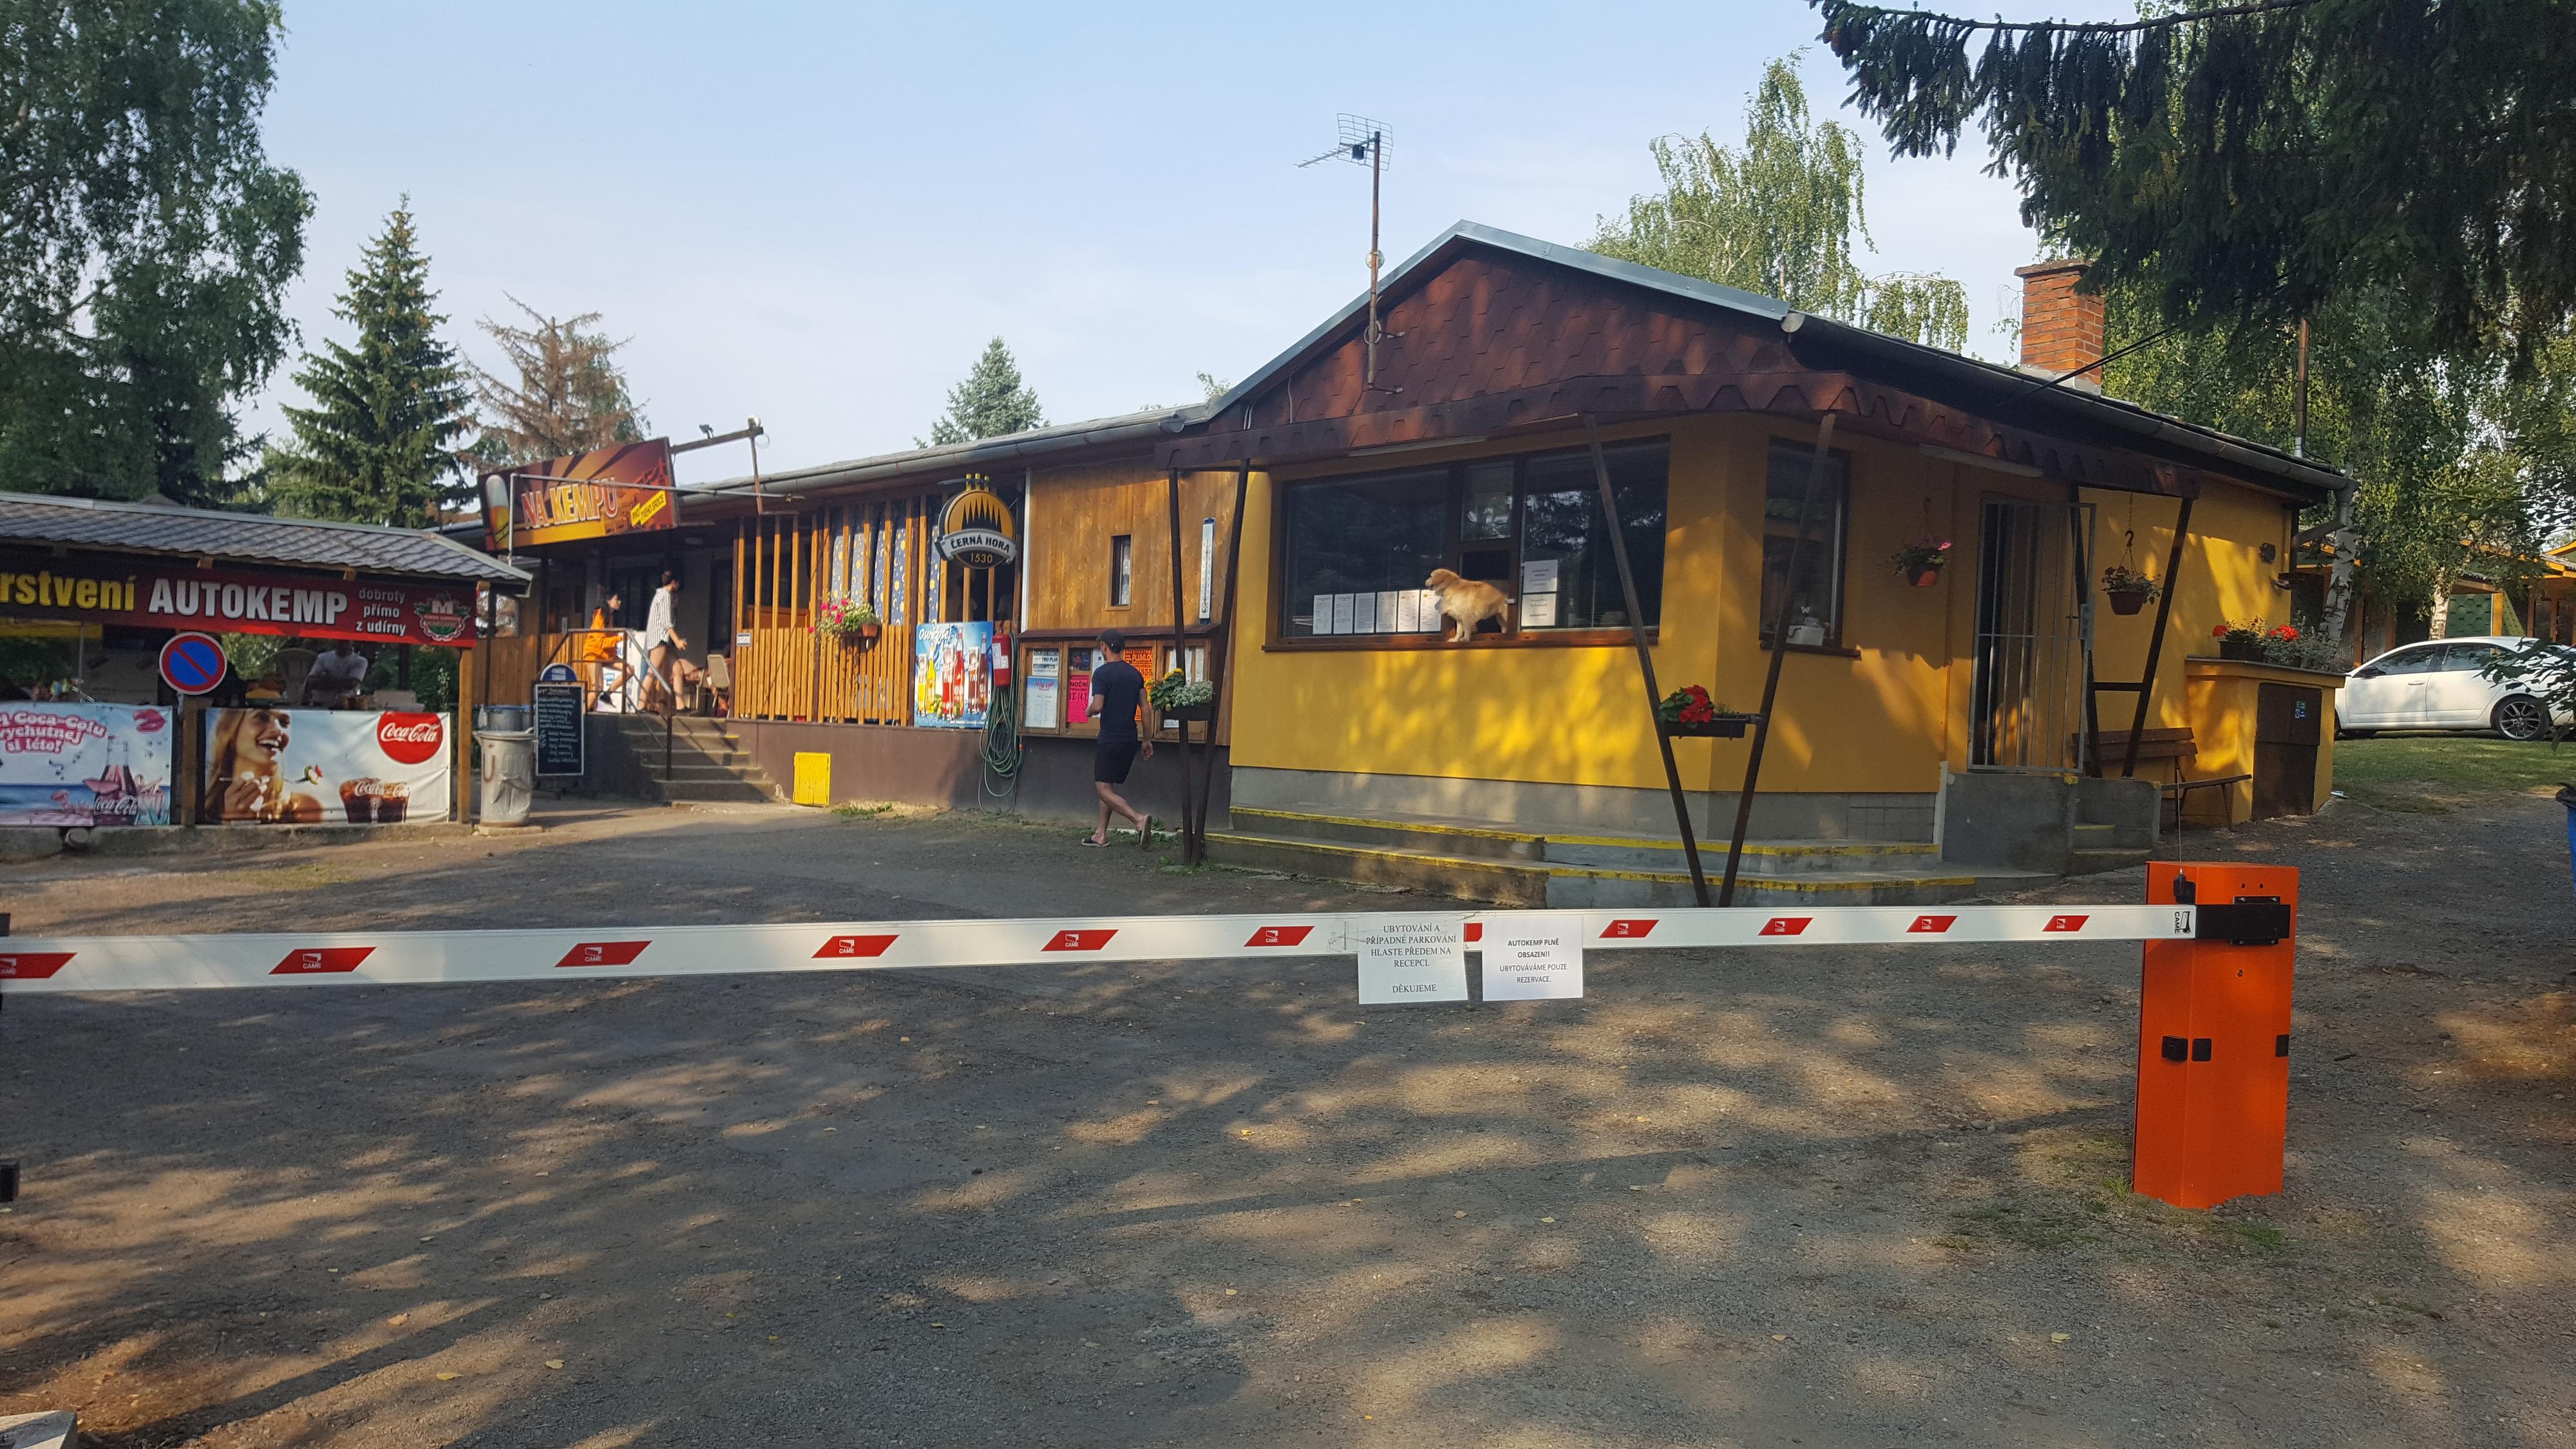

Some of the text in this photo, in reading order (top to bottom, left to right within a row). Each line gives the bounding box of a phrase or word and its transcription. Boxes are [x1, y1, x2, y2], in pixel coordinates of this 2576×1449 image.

[522, 477, 618, 529] NA KEMPU
[950, 535, 1010, 553] ČERNÁ HORA
[971, 553, 992, 564] 1530
[148, 578, 348, 625] AUTOKEMP
[359, 587, 406, 605] dobroty
[363, 603, 400, 618] přímo
[356, 620, 406, 637] z udírny
[14, 711, 108, 736] Coca-Colu
[381, 722, 440, 743] Coca-Cola
[6, 737, 62, 753] si léto!
[1383, 923, 1432, 933] UBYTOVÁNÍ
[1366, 934, 1457, 945] PŘÍPADNÉ PARKOVÁNÍ
[1405, 947, 1437, 956] PŘEDEM
[1394, 959, 1430, 967] RECEPCI.
[1499, 963, 1546, 972] UBYTOVÁVÁME
[1392, 984, 1437, 993] DĚKUJEME
